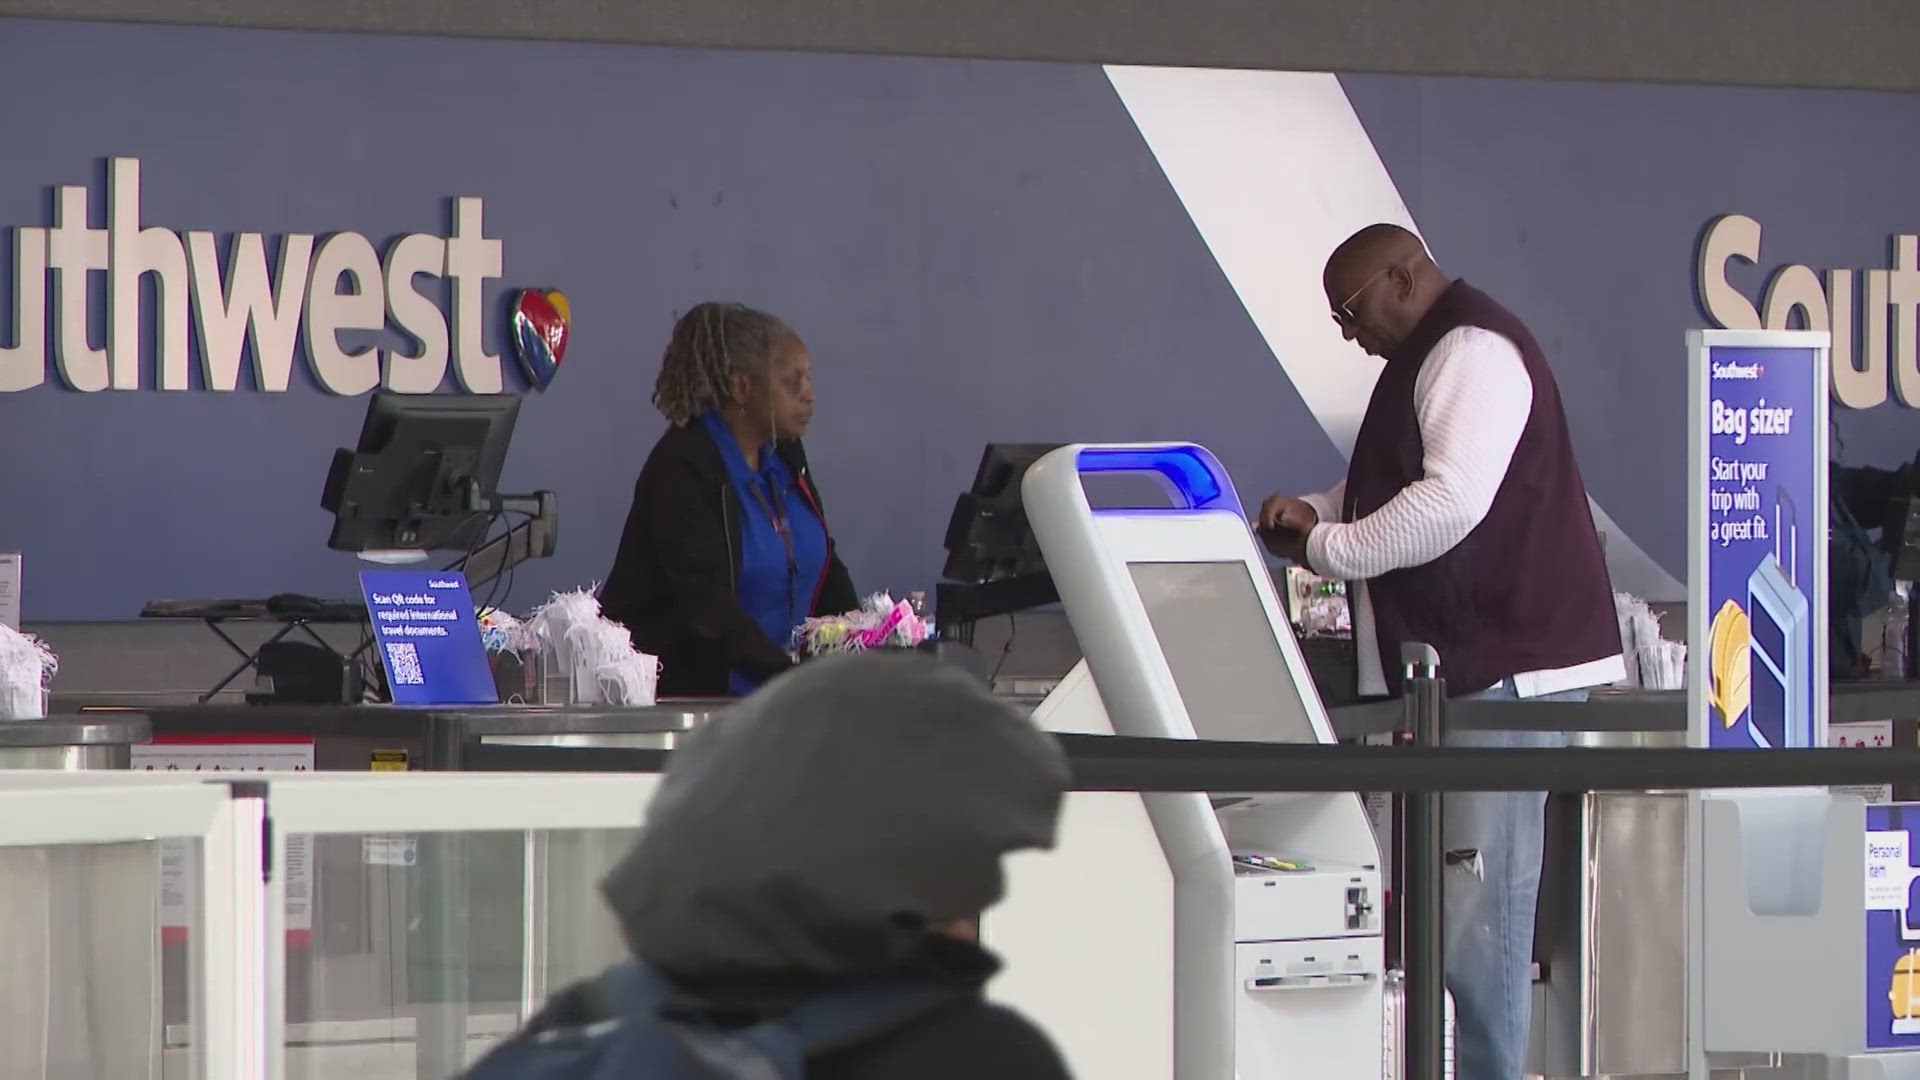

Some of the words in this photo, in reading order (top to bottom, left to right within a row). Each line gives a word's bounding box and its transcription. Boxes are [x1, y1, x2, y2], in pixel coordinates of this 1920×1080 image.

[0, 156, 504, 396] uthwest
[1712, 361, 1759, 379] Southwest
[1712, 399, 1747, 444] Bag
[1750, 397, 1793, 434] sizer
[1711, 456, 1740, 481] Start
[1741, 461, 1768, 486] your
[1711, 487, 1732, 516] trip
[1734, 487, 1760, 511] with
[1711, 522, 1719, 540] a
[1721, 518, 1751, 546] great
[1753, 515, 1769, 539] fit.
[428, 579, 460, 588] Southwest
[372, 592, 392, 605] Scan
[392, 593, 404, 606] QR
[405, 592, 424, 604] code
[424, 593, 436, 605] for
[377, 608, 410, 623] required
[409, 608, 458, 620] international
[381, 624, 404, 636] travel
[404, 624, 449, 636] documents.
[1868, 842, 1903, 859] Personal
[1868, 863, 1887, 878] item
